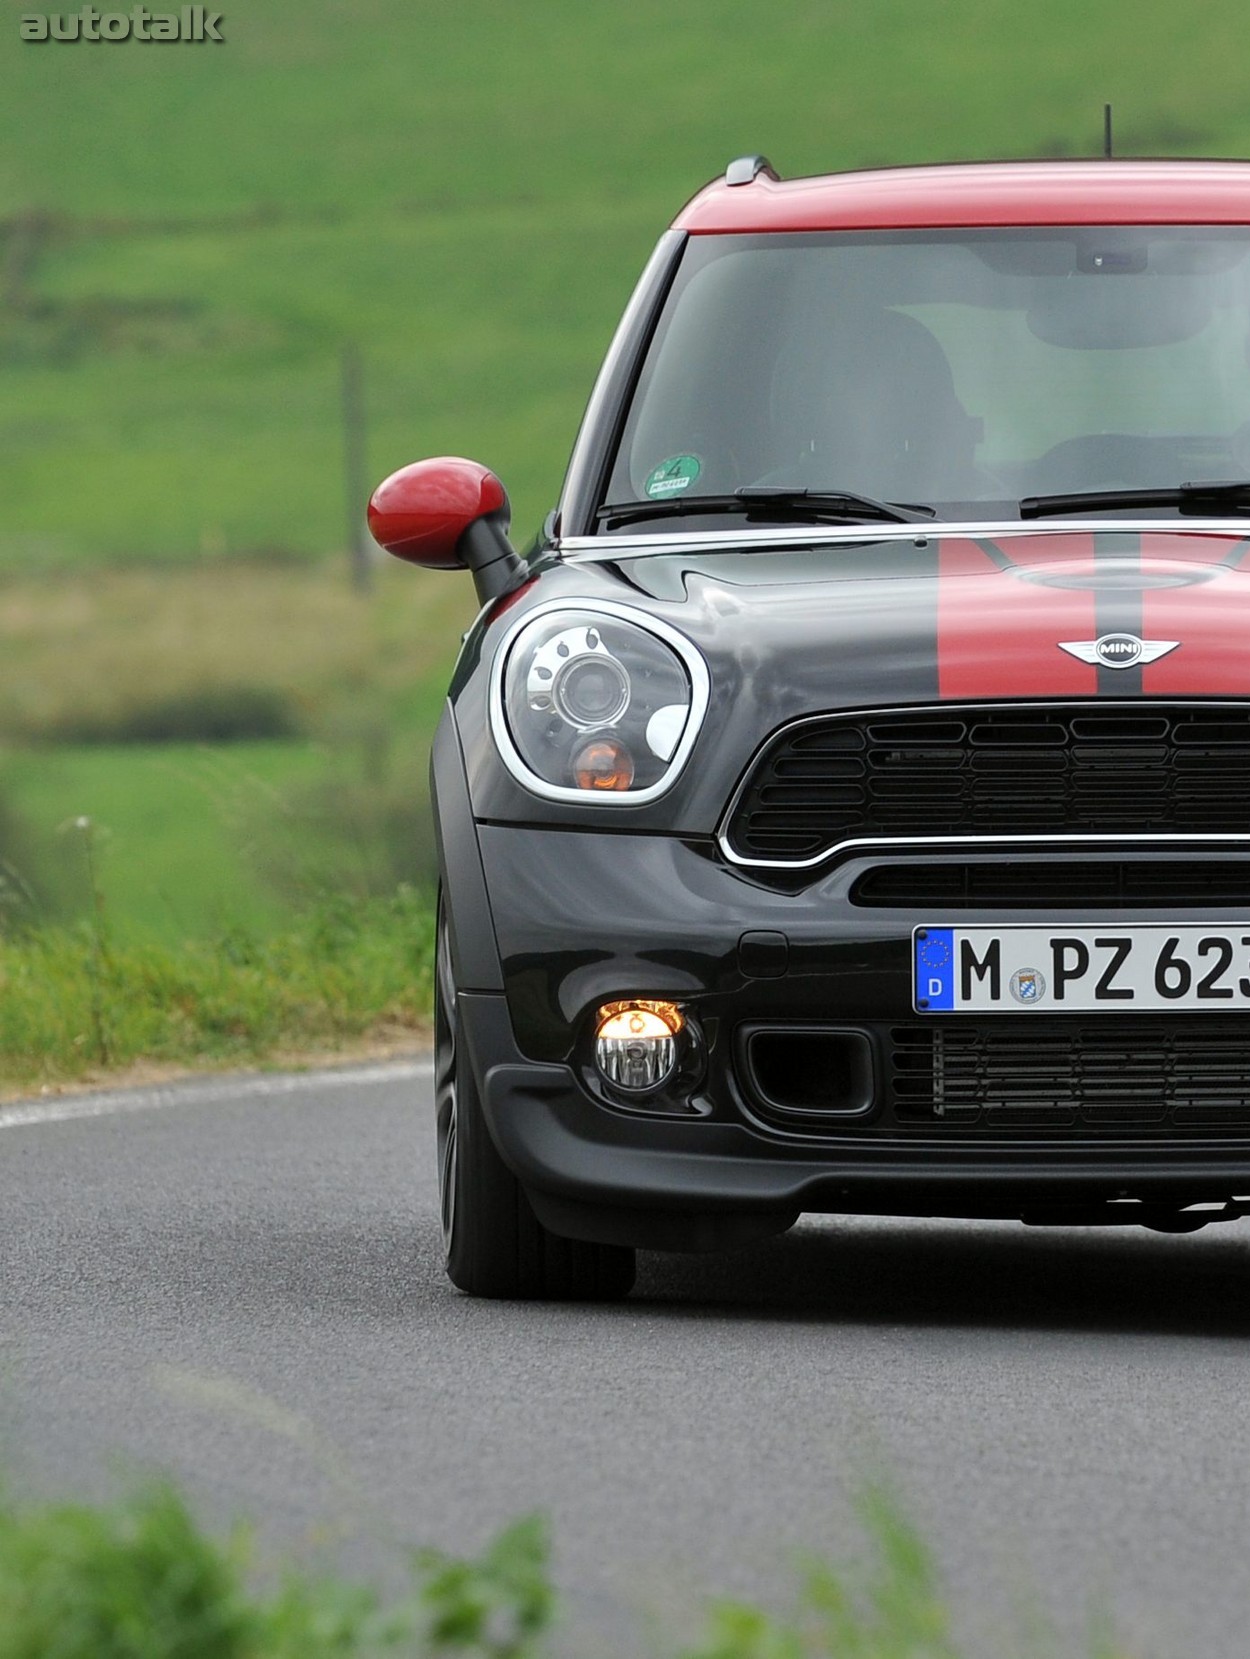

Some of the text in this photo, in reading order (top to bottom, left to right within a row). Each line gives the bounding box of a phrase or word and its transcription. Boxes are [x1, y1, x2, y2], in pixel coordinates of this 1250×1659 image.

[667, 459, 682, 477] 4
[1100, 643, 1138, 654] MINI
[960, 938, 1001, 1001] M
[1049, 937, 1135, 1000] PZ
[928, 978, 943, 997] D
